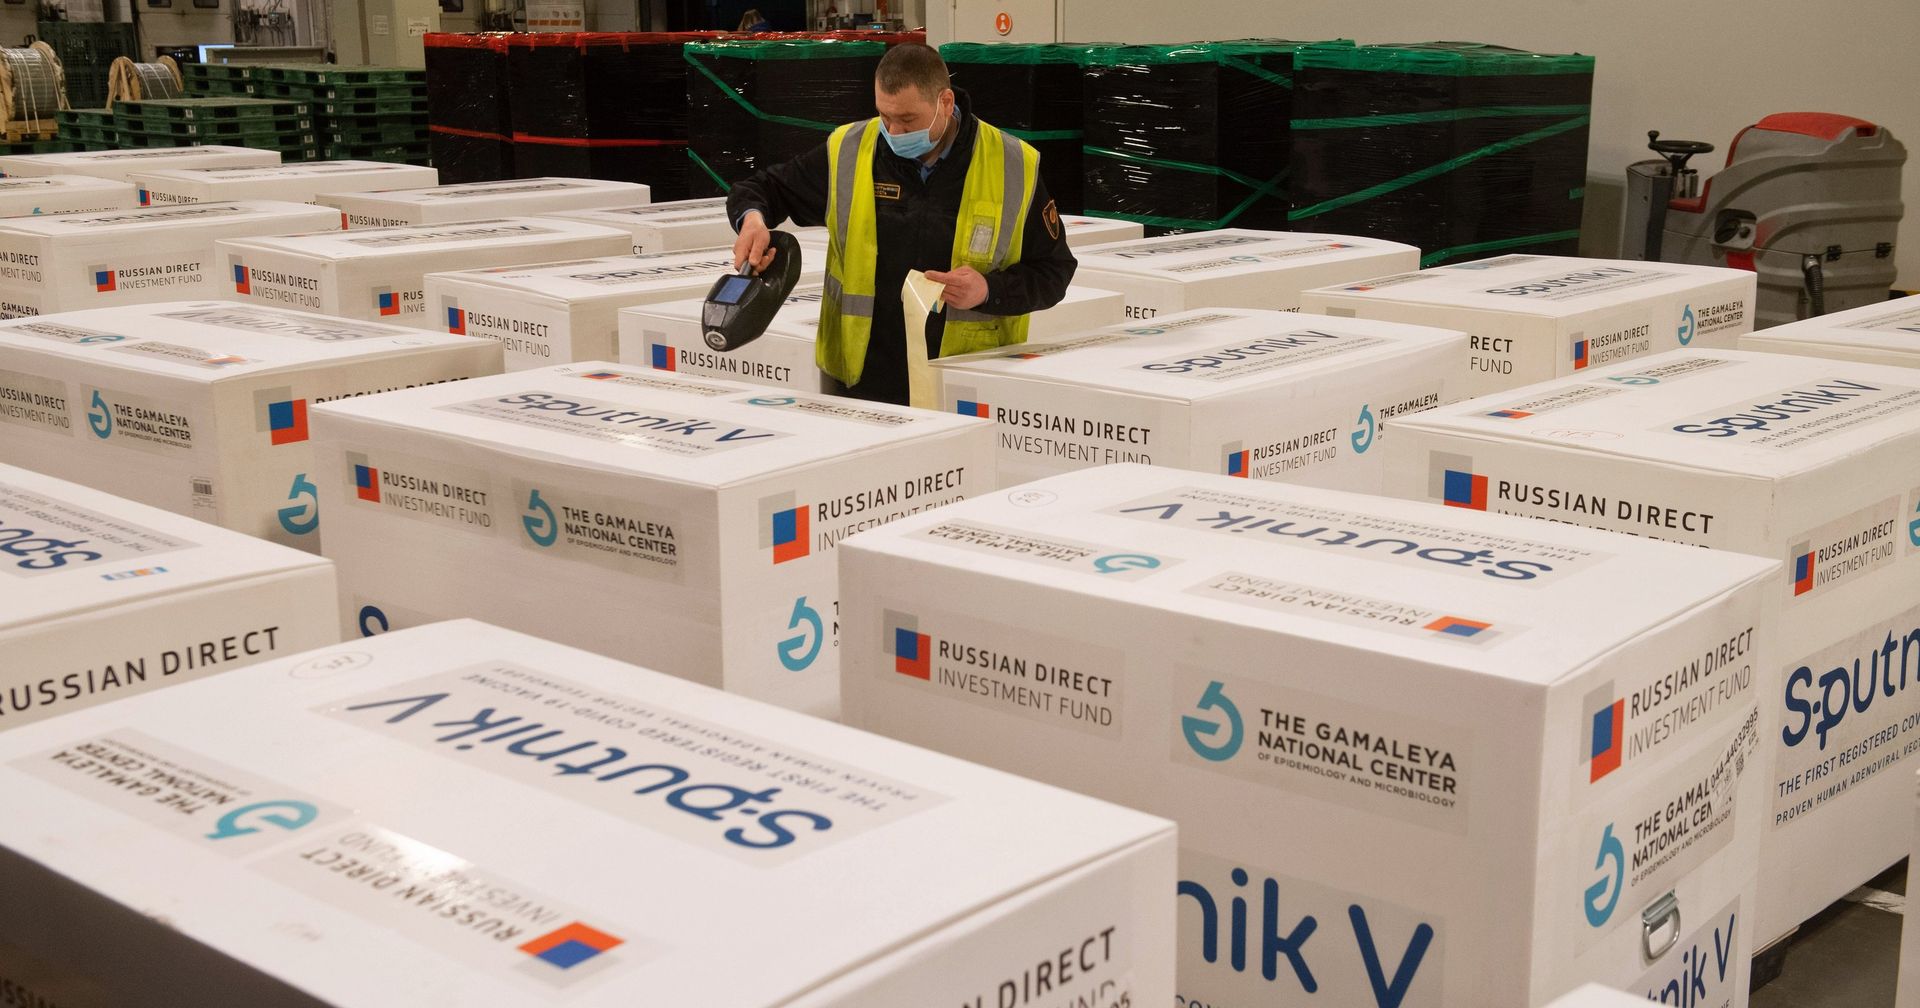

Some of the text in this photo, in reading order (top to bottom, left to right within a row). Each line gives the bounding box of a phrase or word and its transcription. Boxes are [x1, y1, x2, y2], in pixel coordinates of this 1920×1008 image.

[151, 191, 177, 204] RUSSIAN
[349, 214, 381, 228] RUSSIAN
[10, 253, 39, 266] DIRECT
[21, 269, 42, 283] FUND
[119, 262, 201, 278] RUSSIAN DIRECT
[119, 273, 203, 290] INVESTMENT FUND
[251, 268, 319, 292] RUSSIAN DIRECT
[252, 285, 321, 308] INVESTMENT FUND
[403, 290, 424, 301] RUS
[1, 302, 40, 316] GAMALEYA
[403, 302, 425, 313] INVE
[1696, 316, 1723, 330] NATIONAL
[1724, 310, 1744, 324] CENTER
[1698, 299, 1744, 317] THE GAMALEYA
[468, 311, 549, 339] RUSSIAN DIRECT
[1590, 324, 1649, 349] RUSSIAN DIRECT
[525, 341, 551, 358] FUND
[1142, 337, 1318, 373] Sputnik
[1470, 356, 1513, 375] FUND
[1590, 340, 1649, 365] INVESTMENT FUND
[681, 350, 791, 383] RUSSIAN DIRECT
[35, 396, 66, 412] DIRECT
[114, 403, 190, 428] THE GAMALEYA
[498, 394, 716, 436] Sputnik
[714, 428, 775, 442] V
[1380, 405, 1396, 420] THE
[1397, 392, 1439, 415] GAMALEYA
[1672, 389, 1861, 437] Sputnik
[48, 413, 70, 429] FUND
[116, 417, 191, 442] NATIONAL CENTER
[997, 407, 1151, 445] RUSSIAN DIRECT
[997, 431, 1100, 464] INVESTMENT
[1253, 427, 1337, 461] RUSSIAN DIRECT
[1252, 446, 1337, 480] INVESTMENT FUND
[383, 471, 488, 507] RUSSIAN DIRECT
[818, 466, 965, 523] RUSSIAN DIRECT
[385, 492, 491, 528] INVESTMENT FUND
[562, 506, 675, 540] THE GAMALEYA
[1499, 480, 1606, 517] RUSSIAN
[1617, 500, 1714, 534] DIRECT
[564, 523, 677, 556] NATIONAL CENTER
[928, 528, 1032, 553] GAMALEYA
[937, 525, 1001, 541] CENTER
[1007, 538, 1091, 558] NATIONAL
[1196, 511, 1553, 580] Sputnik
[1347, 520, 1466, 544] REGISTERED
[1472, 540, 1530, 554] FIRST
[1817, 519, 1895, 565] RUSSIAN DIRECT
[1034, 551, 1076, 562] THE
[1535, 550, 1576, 562] THE
[1816, 541, 1894, 588] INVESTMENT FUND
[1208, 582, 1418, 626] RUSSIAN DIRECT
[1225, 574, 1434, 619] INVESTMENT FUND
[161, 626, 280, 676] DIRECT
[940, 640, 1113, 698] RUSSIAN DIRECT
[1630, 626, 1754, 720] RUSSIAN DIRECT
[939, 667, 1113, 727] INVESTMENT FUND
[1628, 686, 1716, 761] INVESTMENT
[1717, 664, 1751, 706] FUND
[75, 742, 147, 771] CENTER
[637, 727, 769, 772] REGISTERED
[1260, 708, 1457, 773] THE GAMALEYA
[51, 750, 161, 797] GAMALEYA
[345, 692, 833, 849] Sputnik V
[1258, 731, 1456, 794] NATIONAL CENTER
[1778, 773, 1801, 798] THE
[1804, 757, 1837, 786] FIRST
[1839, 722, 1899, 768] REGISTERED
[147, 767, 237, 806] NATIONAL
[765, 769, 838, 794] FIRST
[1258, 752, 1456, 809] OF EPIDEMIOLOGY AND MICROBIOLOGY
[1775, 753, 1901, 826] PROVEN HUMAN ADENOVIRAL
[155, 795, 207, 816] THE
[838, 791, 888, 812] THE
[1634, 813, 1662, 845] THE
[1630, 875, 1639, 887] OF
[1639, 844, 1681, 884] EPIDEMIOLOGY
[1681, 836, 1693, 850] AND
[1631, 823, 1689, 872] NATIONAL
[300, 847, 525, 943] RUSSIAN DIRECT
[1347, 904, 1434, 1008] V
[1714, 912, 1736, 983] V
[998, 925, 1116, 1008] DIRECT
